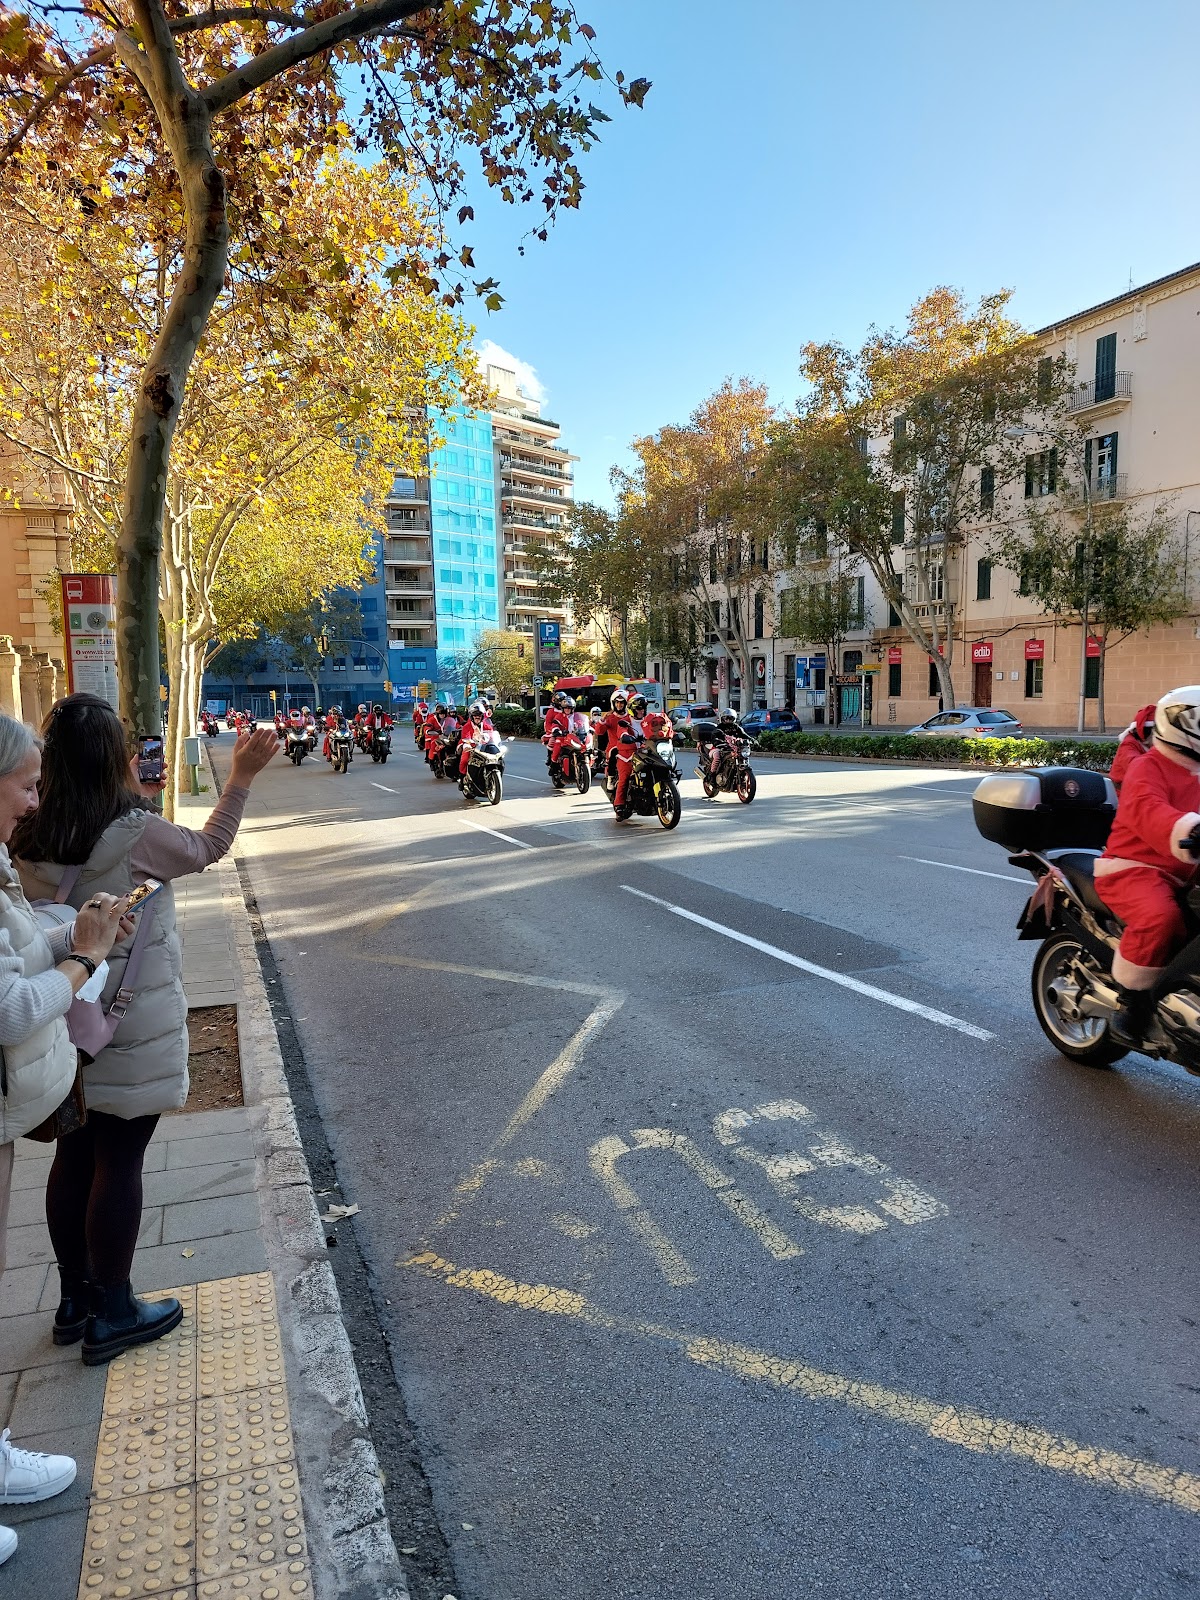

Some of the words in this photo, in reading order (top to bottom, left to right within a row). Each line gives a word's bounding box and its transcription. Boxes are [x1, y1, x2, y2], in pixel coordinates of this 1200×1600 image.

[545, 624, 554, 636] P
[973, 646, 991, 658] edib
[512, 1098, 950, 1289] BU
